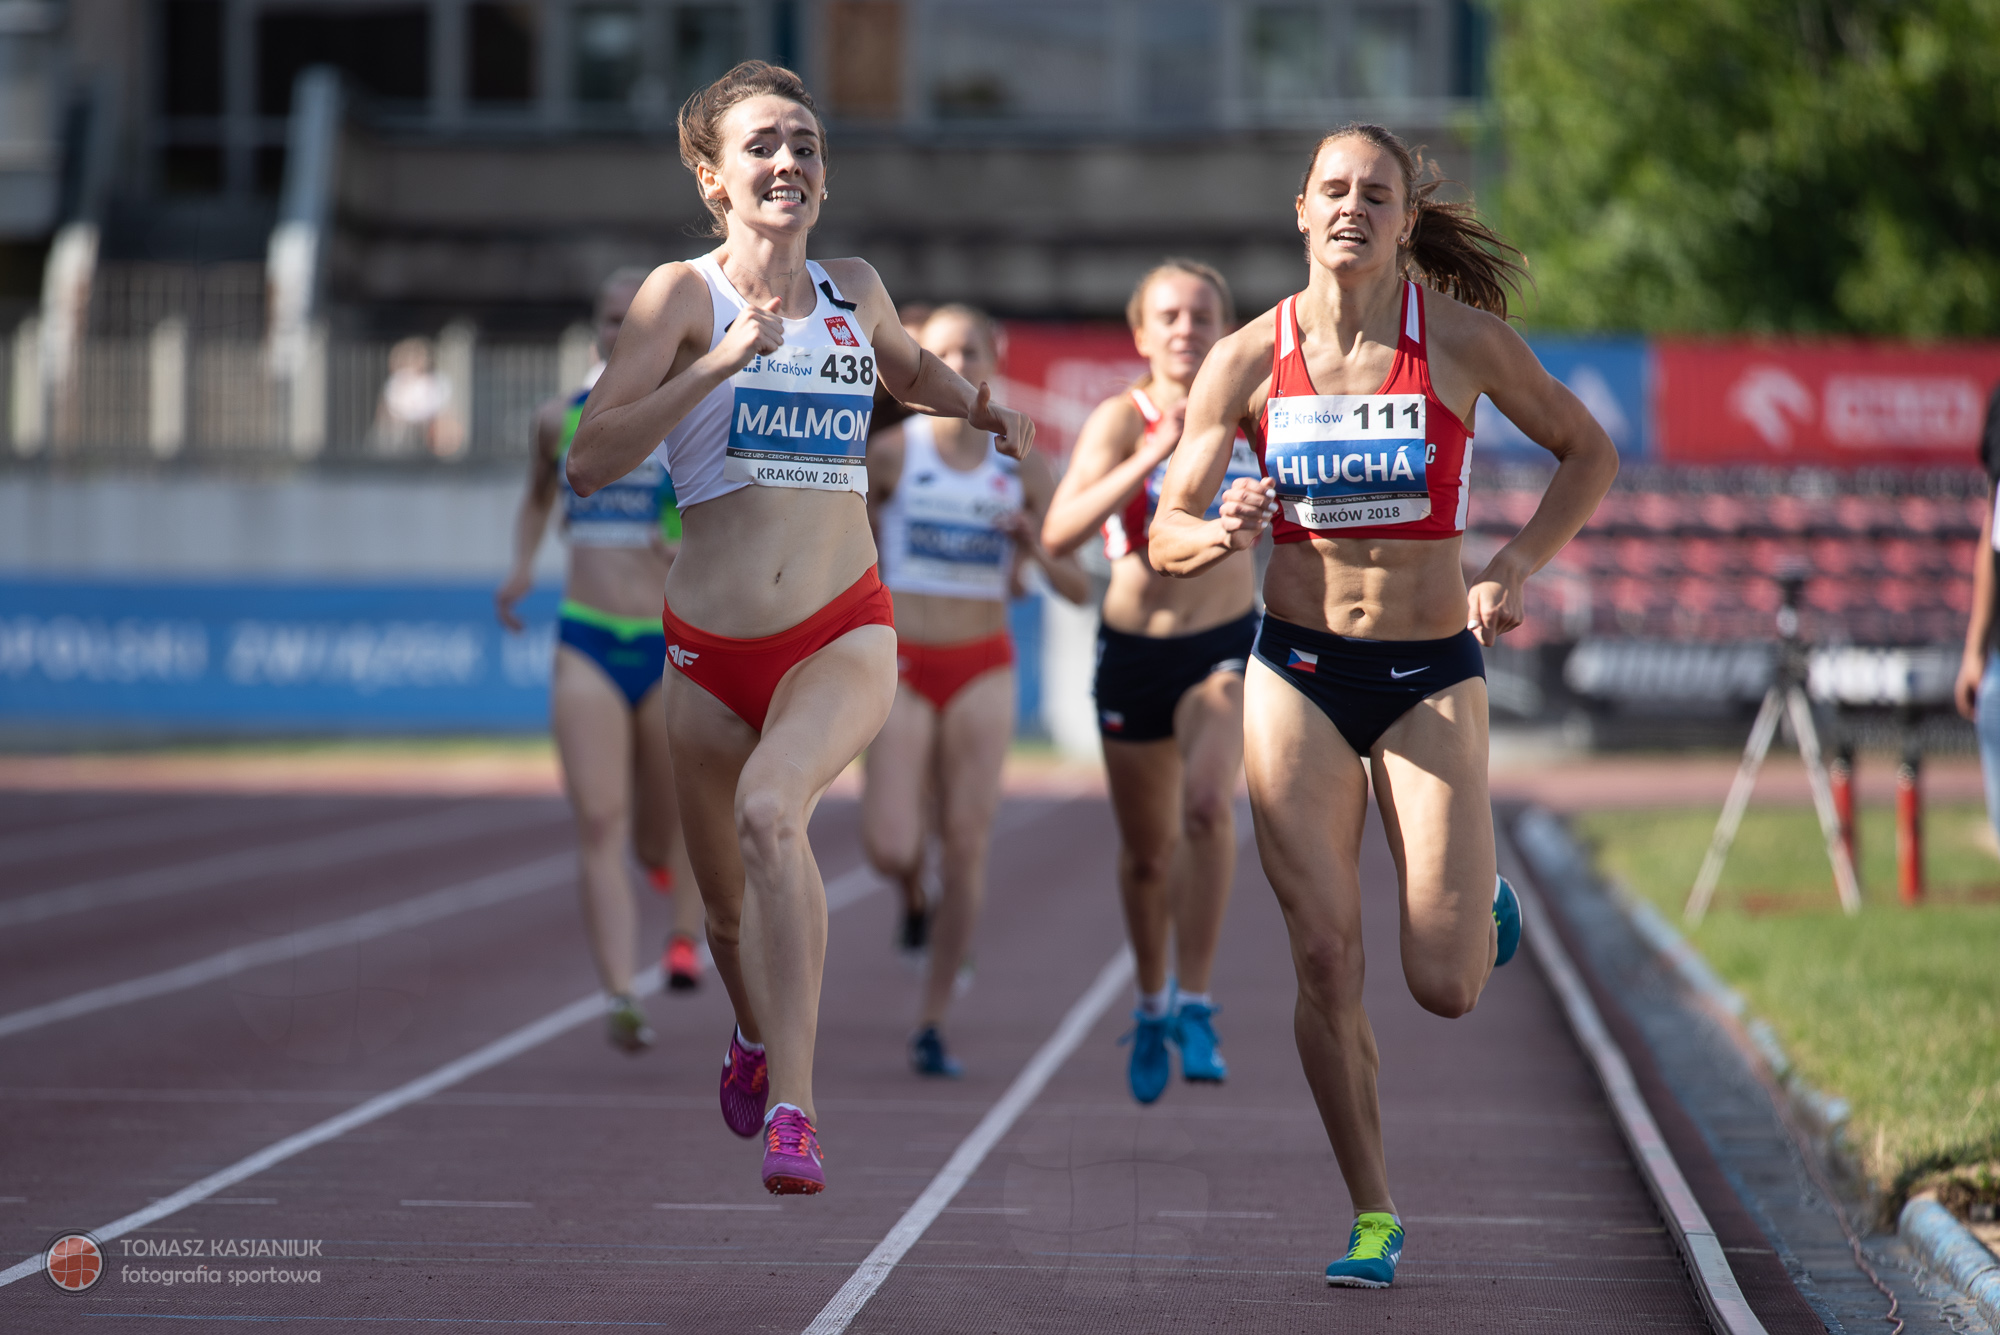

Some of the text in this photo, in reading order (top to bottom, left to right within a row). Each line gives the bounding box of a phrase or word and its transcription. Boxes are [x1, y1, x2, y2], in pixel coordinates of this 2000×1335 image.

[767, 359, 812, 376] Kraków
[820, 354, 874, 385] 438
[736, 402, 870, 441] MALMON
[1294, 410, 1343, 424] Kraków
[1353, 402, 1419, 429] 111
[757, 467, 849, 484] KRAKÓW 2018
[1276, 445, 1415, 485] HLUCHÁ
[1304, 506, 1400, 523] KRAKÓW 2018
